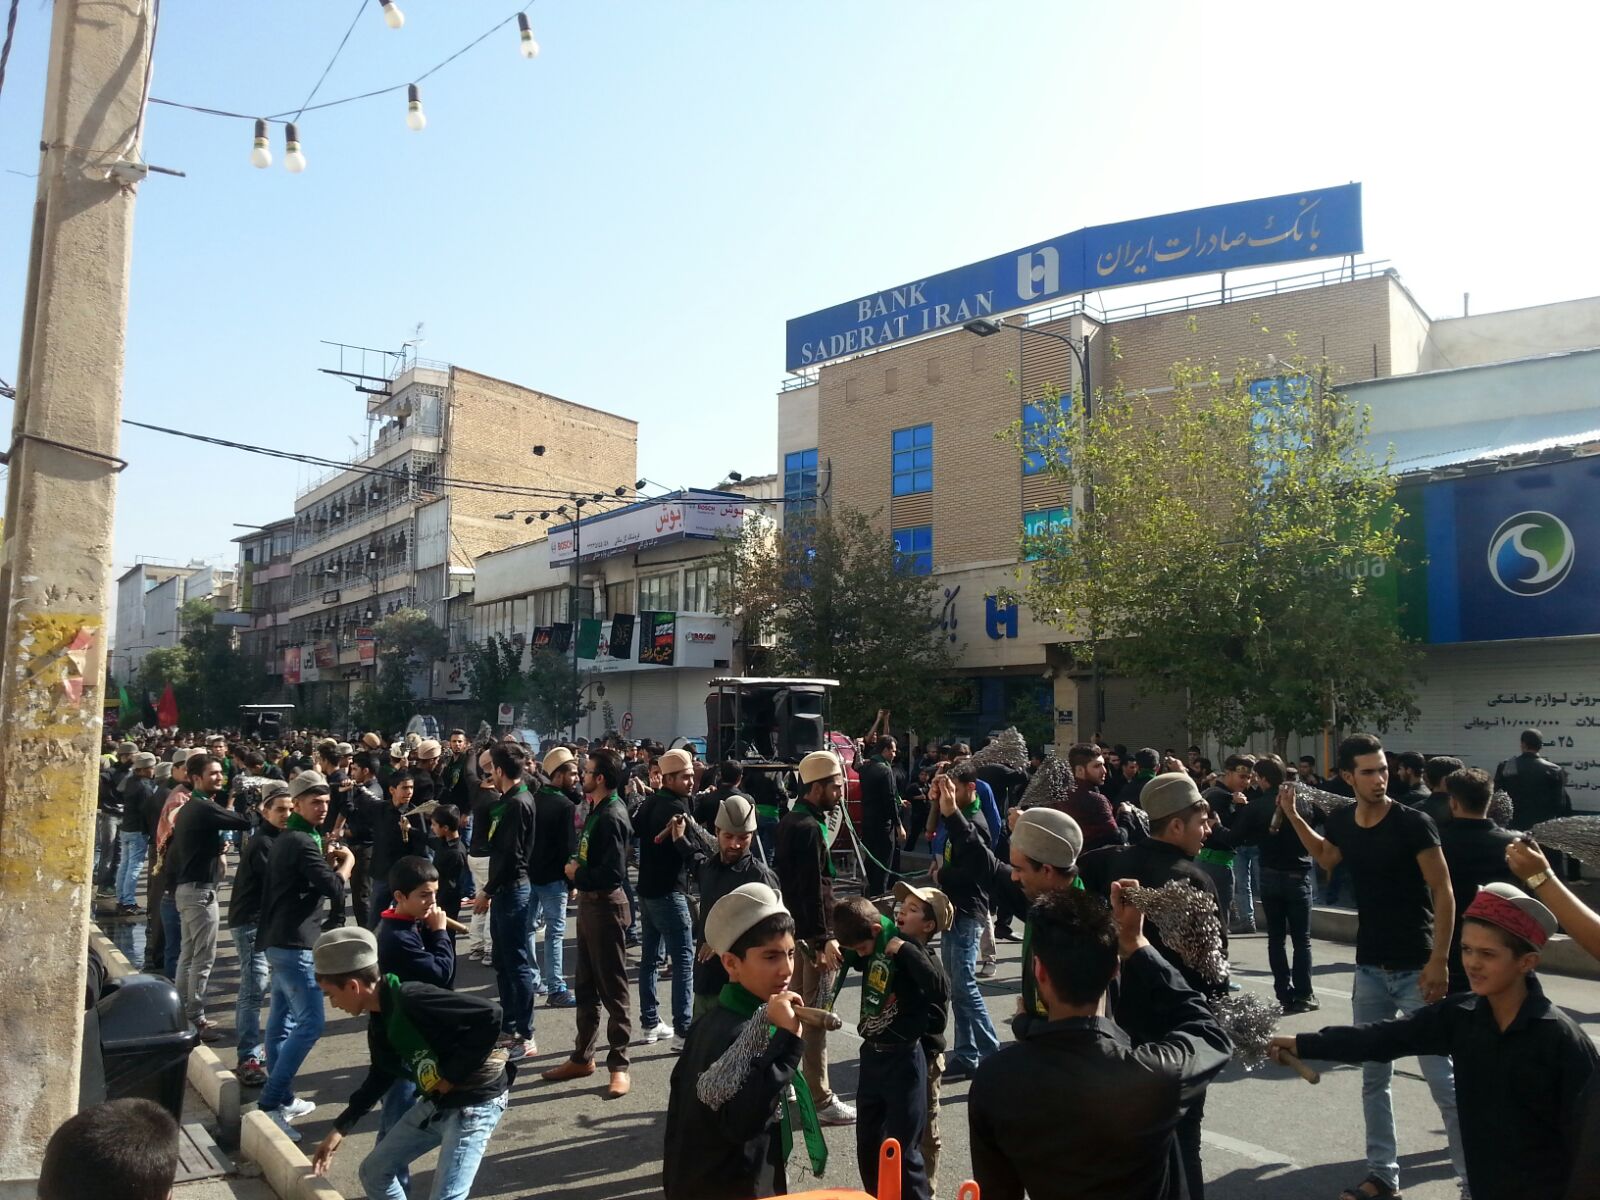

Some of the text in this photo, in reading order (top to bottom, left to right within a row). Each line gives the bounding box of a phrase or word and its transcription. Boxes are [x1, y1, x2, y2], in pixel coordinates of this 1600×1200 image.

[1096, 197, 1322, 277] بانک صادرات ایران
[857, 281, 928, 323] BANK
[801, 289, 994, 366] SADERAT IRAN
[656, 503, 682, 533] بوش
[1570, 692, 1600, 707] روش
